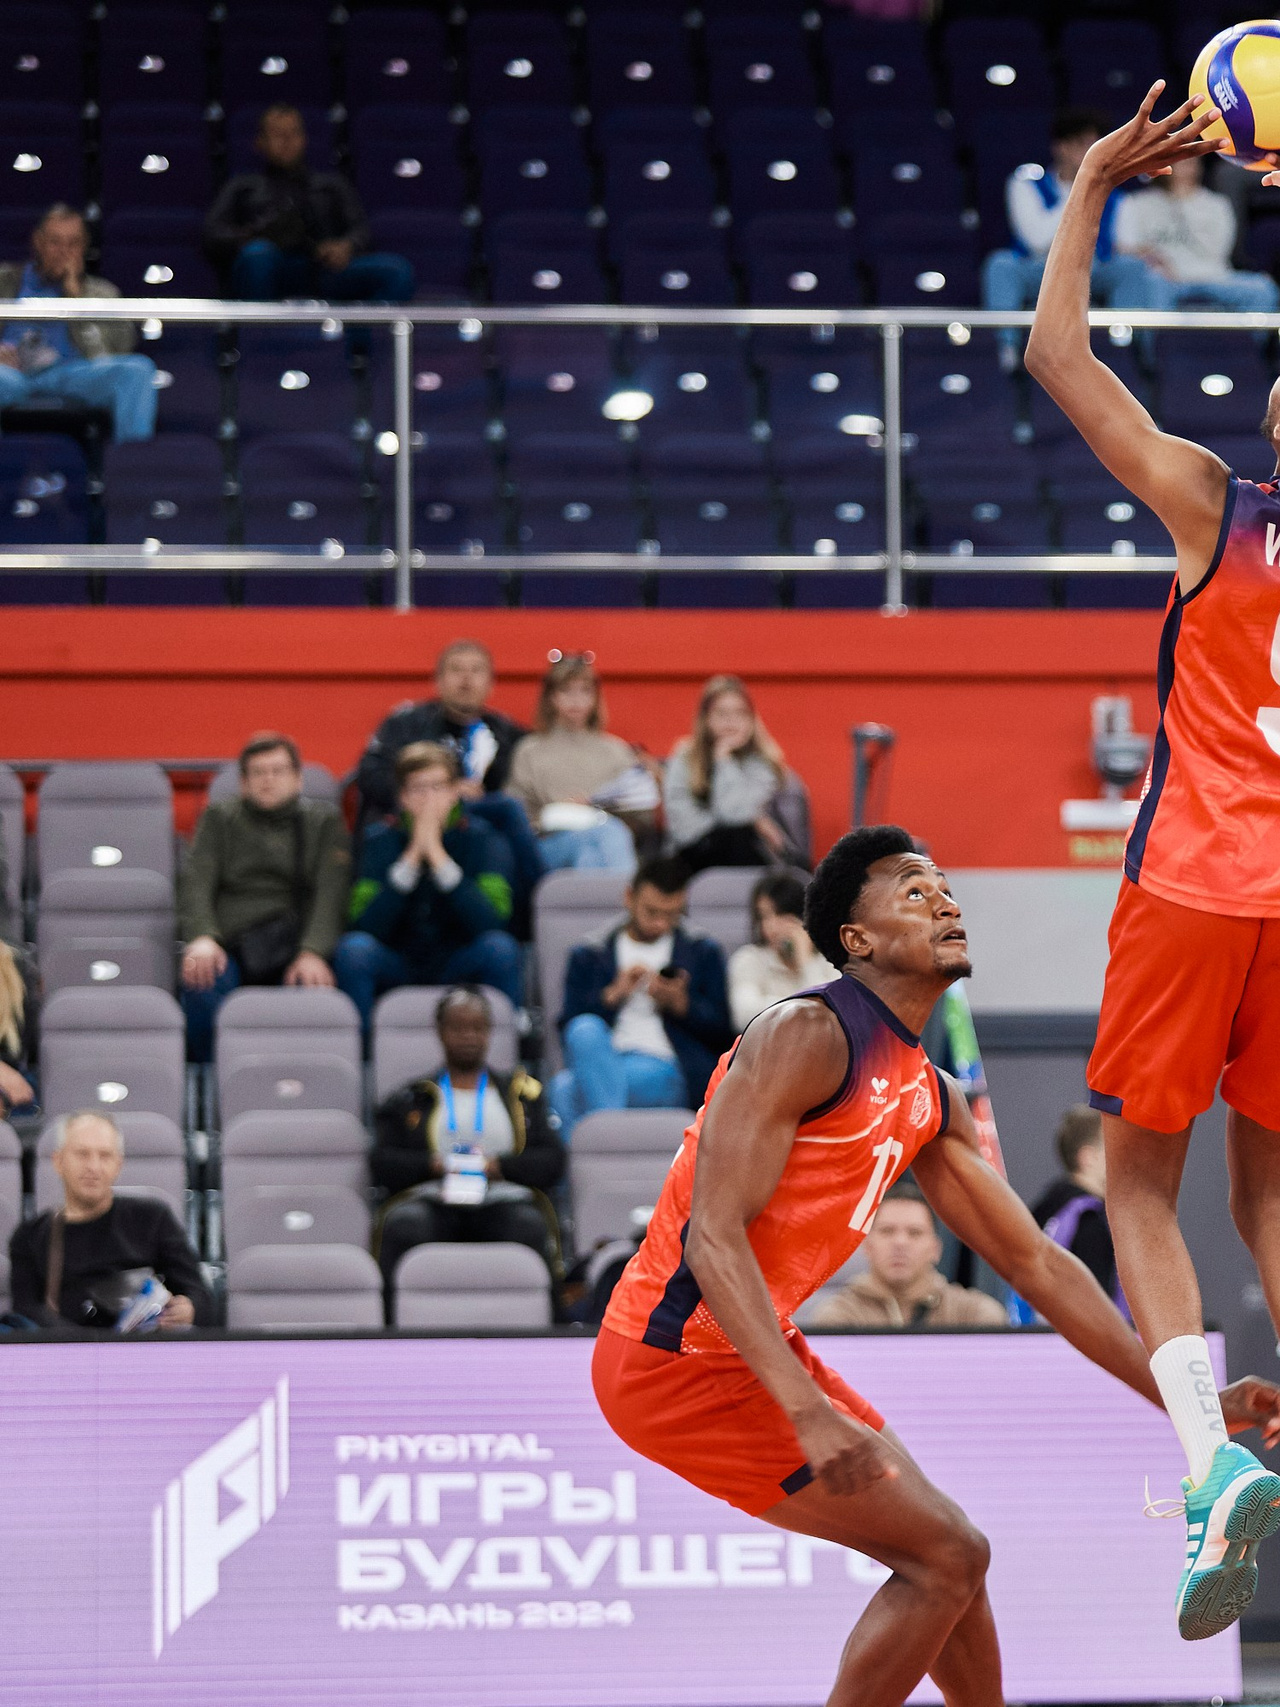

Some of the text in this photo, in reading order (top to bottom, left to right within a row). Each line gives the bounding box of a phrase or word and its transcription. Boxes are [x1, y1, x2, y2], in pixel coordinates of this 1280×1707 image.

[1188, 1360, 1228, 1435] AERO
[337, 1433, 554, 1462] PHYGITAL
[338, 1470, 637, 1526] ИГРЫ
[338, 1600, 635, 1631] КАЗАНЬ 2024
